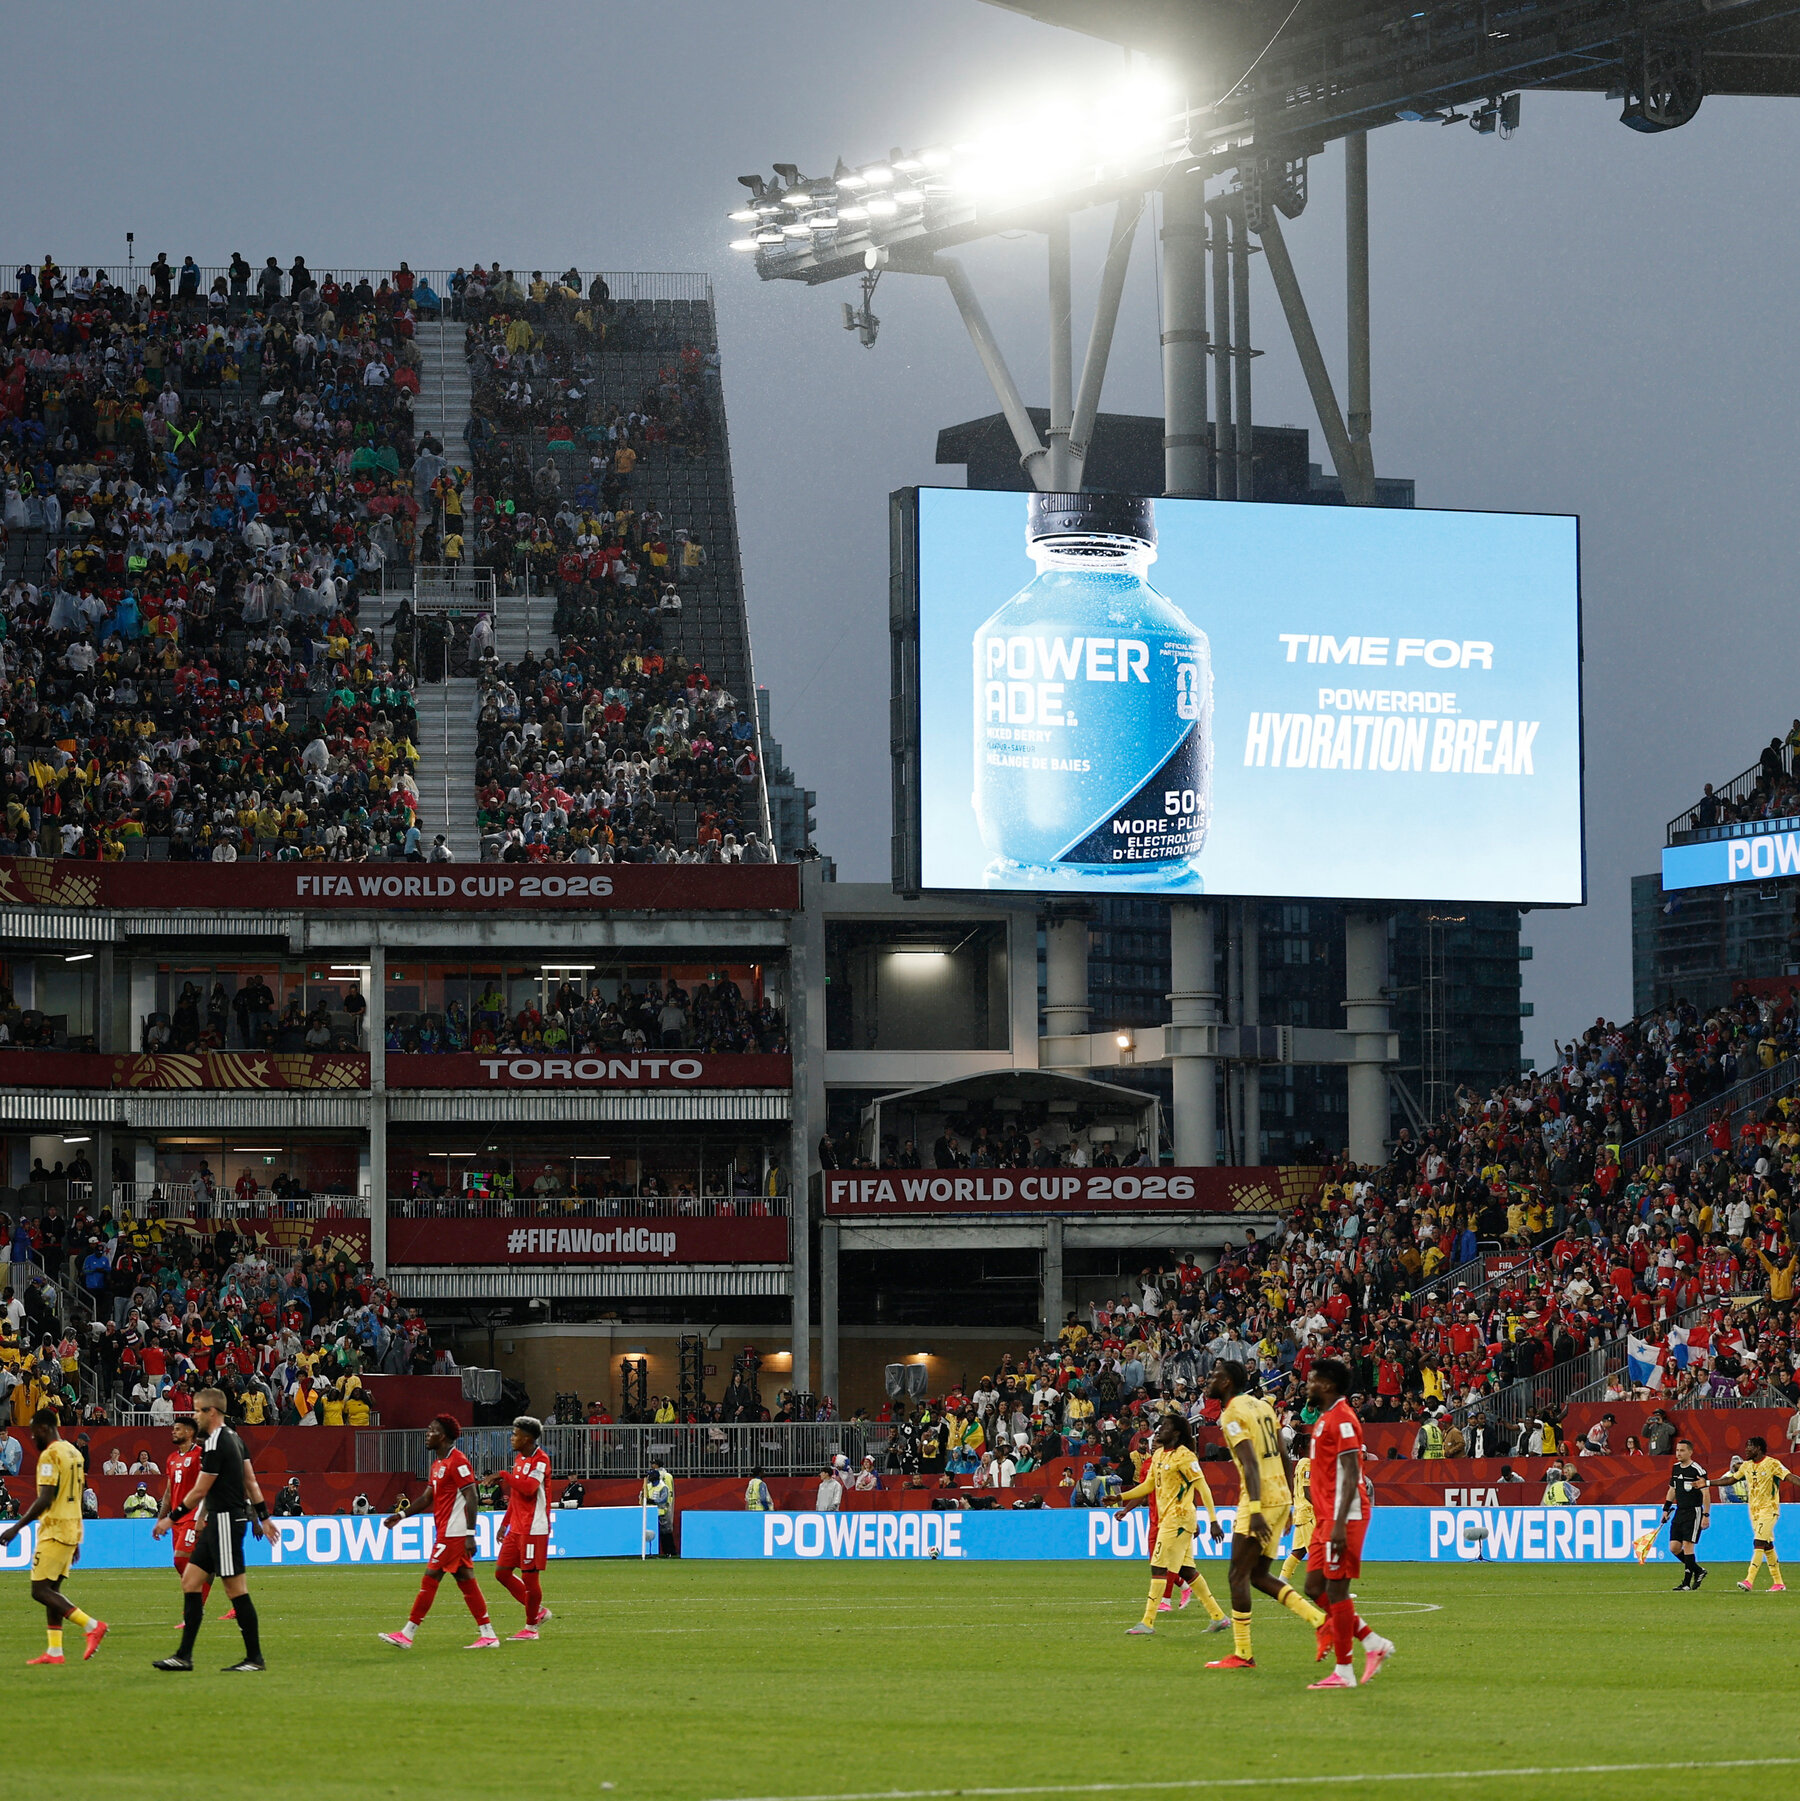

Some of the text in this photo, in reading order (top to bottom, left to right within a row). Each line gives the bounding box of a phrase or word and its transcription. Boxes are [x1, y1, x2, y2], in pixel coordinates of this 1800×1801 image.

[986, 636, 1151, 683] POWER
[1279, 633, 1494, 670] TIME FOR
[1014, 728, 1052, 743] BERRY
[1243, 711, 1540, 776] HYDRATION BREAK
[1032, 757, 1048, 770] DE
[1051, 758, 1091, 772] BAIES
[1165, 789, 1206, 815] 50%
[1113, 814, 1205, 834] MORE PLUS
[1127, 829, 1205, 848] ELECTROLYTES
[296, 876, 613, 897] FIFA WORLD CUP 2026
[479, 1059, 703, 1080] TORONTO
[831, 1176, 1195, 1203] FIFA WORLD CUP 2026
[507, 1227, 676, 1257] #FIFAWorldCup
[174, 1469, 182, 1484] 16
[1444, 1488, 1499, 1506] FIFA
[184, 1528, 196, 1543] 16
[763, 1513, 963, 1557] POWERADE
[1430, 1509, 1658, 1559] POWERADE
[433, 1543, 447, 1559] 7
[525, 1543, 535, 1559] 11
